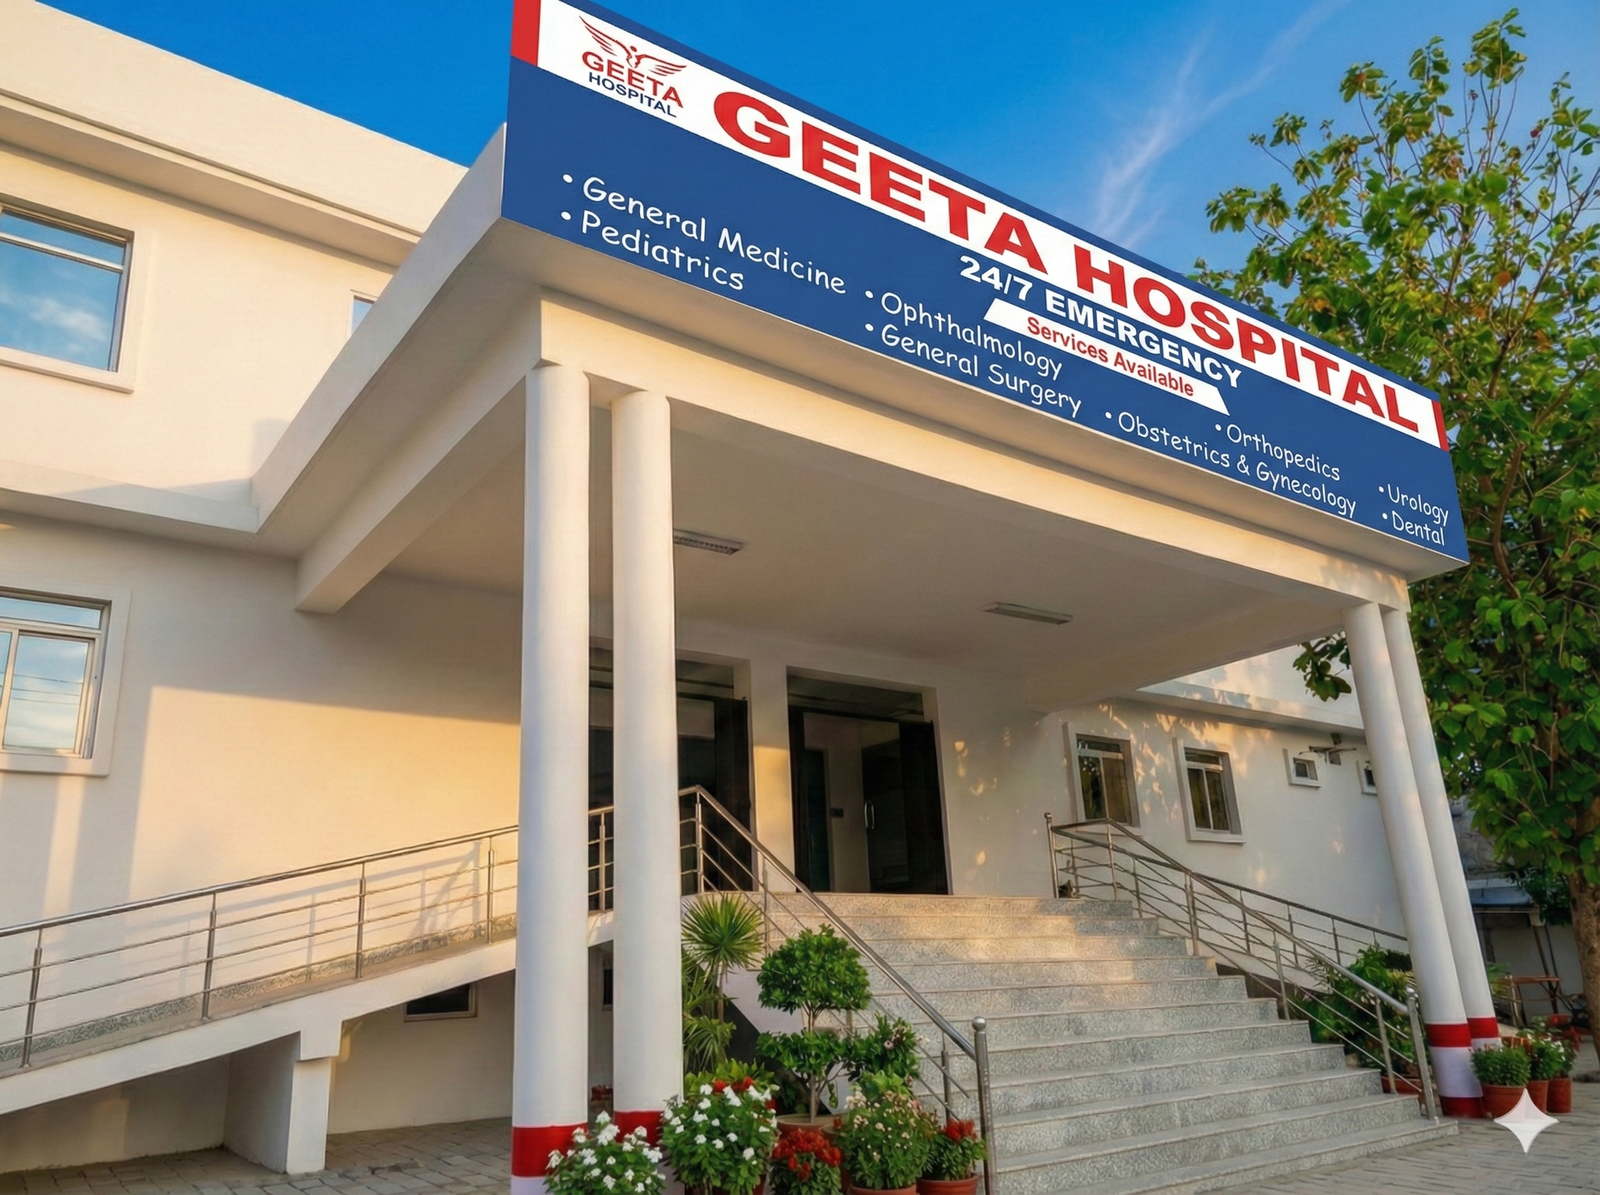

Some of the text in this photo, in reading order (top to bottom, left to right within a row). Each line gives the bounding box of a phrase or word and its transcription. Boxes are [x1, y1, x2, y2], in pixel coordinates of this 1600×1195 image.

[581, 50, 684, 109] GEETA
[588, 72, 677, 118] HOSPITAL
[582, 211, 744, 290] Pediatrics
[583, 176, 846, 295] General Medicine
[713, 91, 1419, 433] GEETA HOSPITAL
[881, 292, 1062, 380] Ophthalmology
[959, 255, 1242, 388] 24/7 EMERGENCY
[1027, 316, 1194, 397] Services Available
[881, 323, 1082, 418] General Surgery
[1118, 411, 1356, 518] Obstetrics & Gynecology
[1226, 424, 1340, 481] Orthopedics
[1387, 486, 1449, 526] Urology
[1392, 511, 1445, 546] Dental
